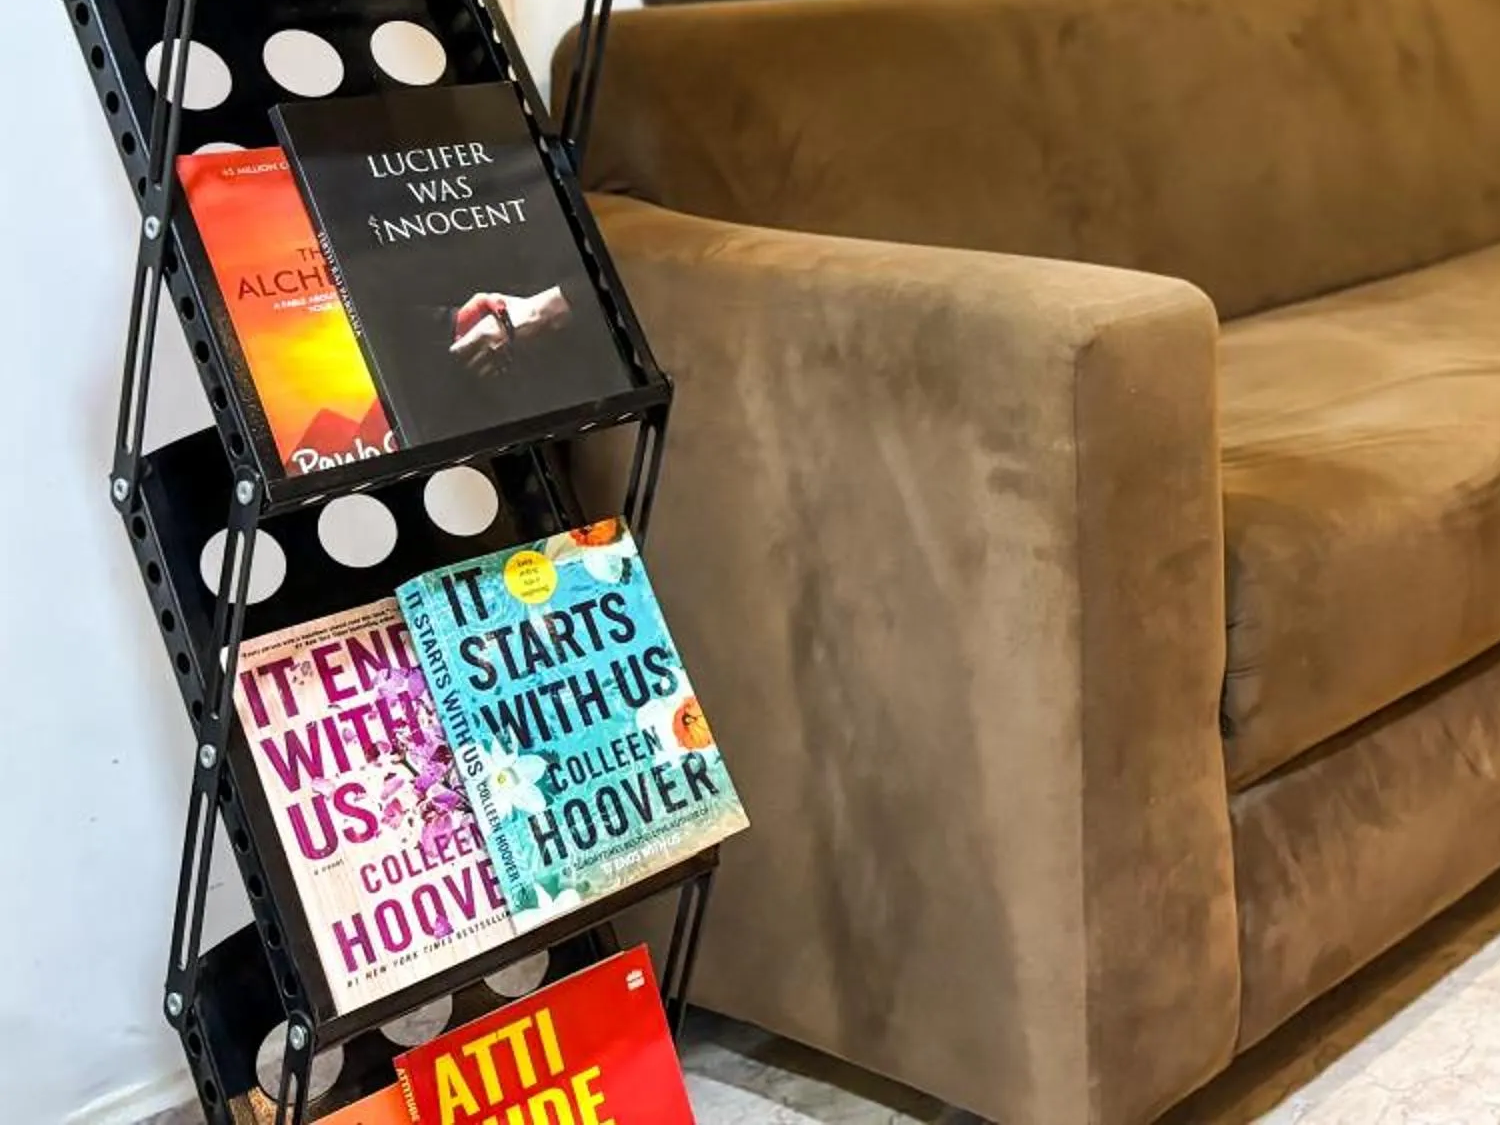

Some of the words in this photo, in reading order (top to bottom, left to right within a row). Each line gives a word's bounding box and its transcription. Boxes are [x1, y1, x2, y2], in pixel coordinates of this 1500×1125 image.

[367, 142, 494, 178] LUCIFER
[406, 176, 473, 204] WAS
[238, 266, 335, 300] ALCH
[297, 247, 322, 262] TH
[441, 567, 489, 628] IT
[459, 592, 636, 692] STARTS
[239, 656, 300, 729] IT
[405, 590, 424, 610] IT
[415, 612, 451, 690] STARTS
[441, 690, 478, 753] WITH
[462, 750, 484, 778] US
[480, 668, 611, 755] WITH
[610, 646, 679, 708] US
[260, 690, 427, 793] WITH
[550, 725, 666, 793] COLLEEN
[286, 782, 379, 860] US
[475, 780, 500, 835] COLLEEN
[494, 833, 520, 884] HOOVER
[528, 752, 719, 867] HOOVER
[332, 858, 507, 973] HOOVE
[434, 1007, 565, 1125] ATTI
